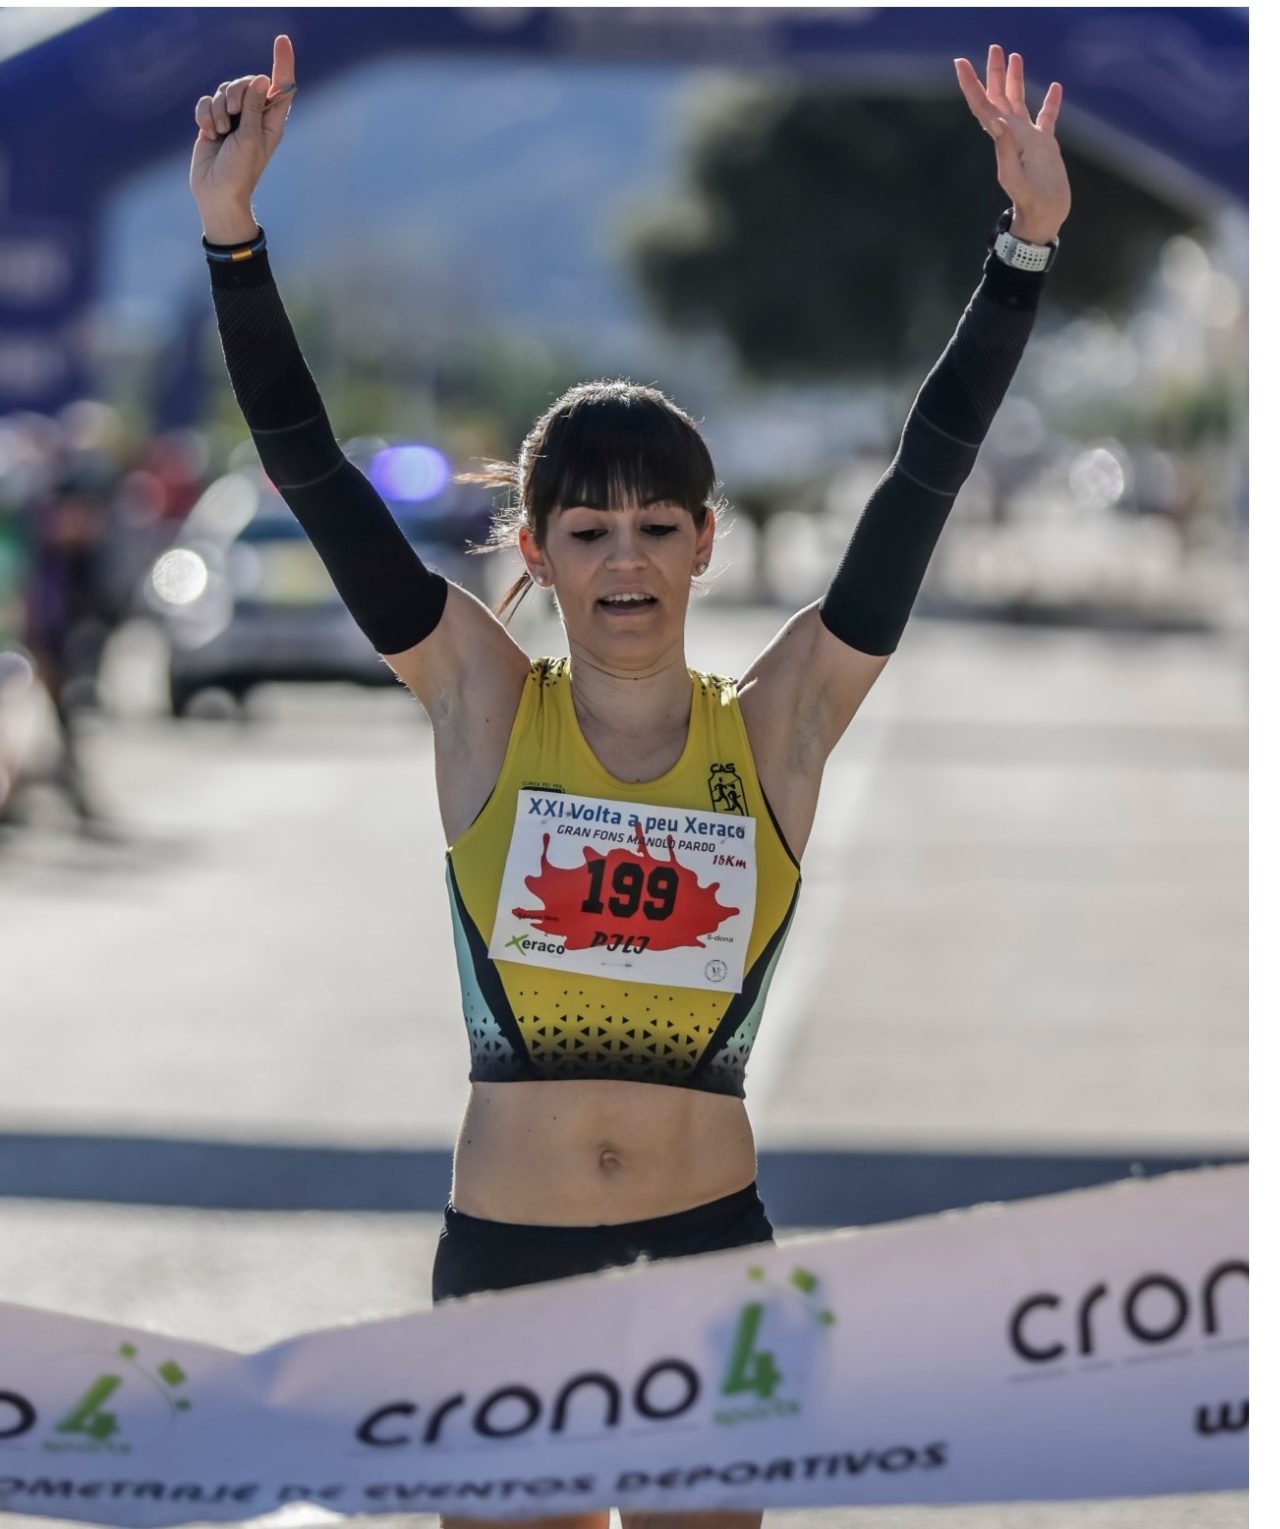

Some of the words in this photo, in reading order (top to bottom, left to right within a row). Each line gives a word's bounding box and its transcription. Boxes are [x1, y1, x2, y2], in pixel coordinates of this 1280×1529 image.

[710, 763, 736, 773] CAS
[527, 797, 564, 818] XXI
[569, 802, 622, 826] Volta
[627, 814, 640, 827] a
[645, 817, 678, 834] peu
[684, 815, 746, 840] Xeraco
[557, 824, 590, 838] GRAN
[593, 830, 624, 843] FONS
[627, 836, 676, 849] MANOLO
[678, 840, 716, 853] PARDO
[580, 859, 680, 922] 199
[504, 934, 566, 956] Xeraco
[356, 1356, 702, 1449] crono
[362, 1474, 596, 1501] EVENTOS
[612, 1441, 950, 1493] DEPORTIVOS
